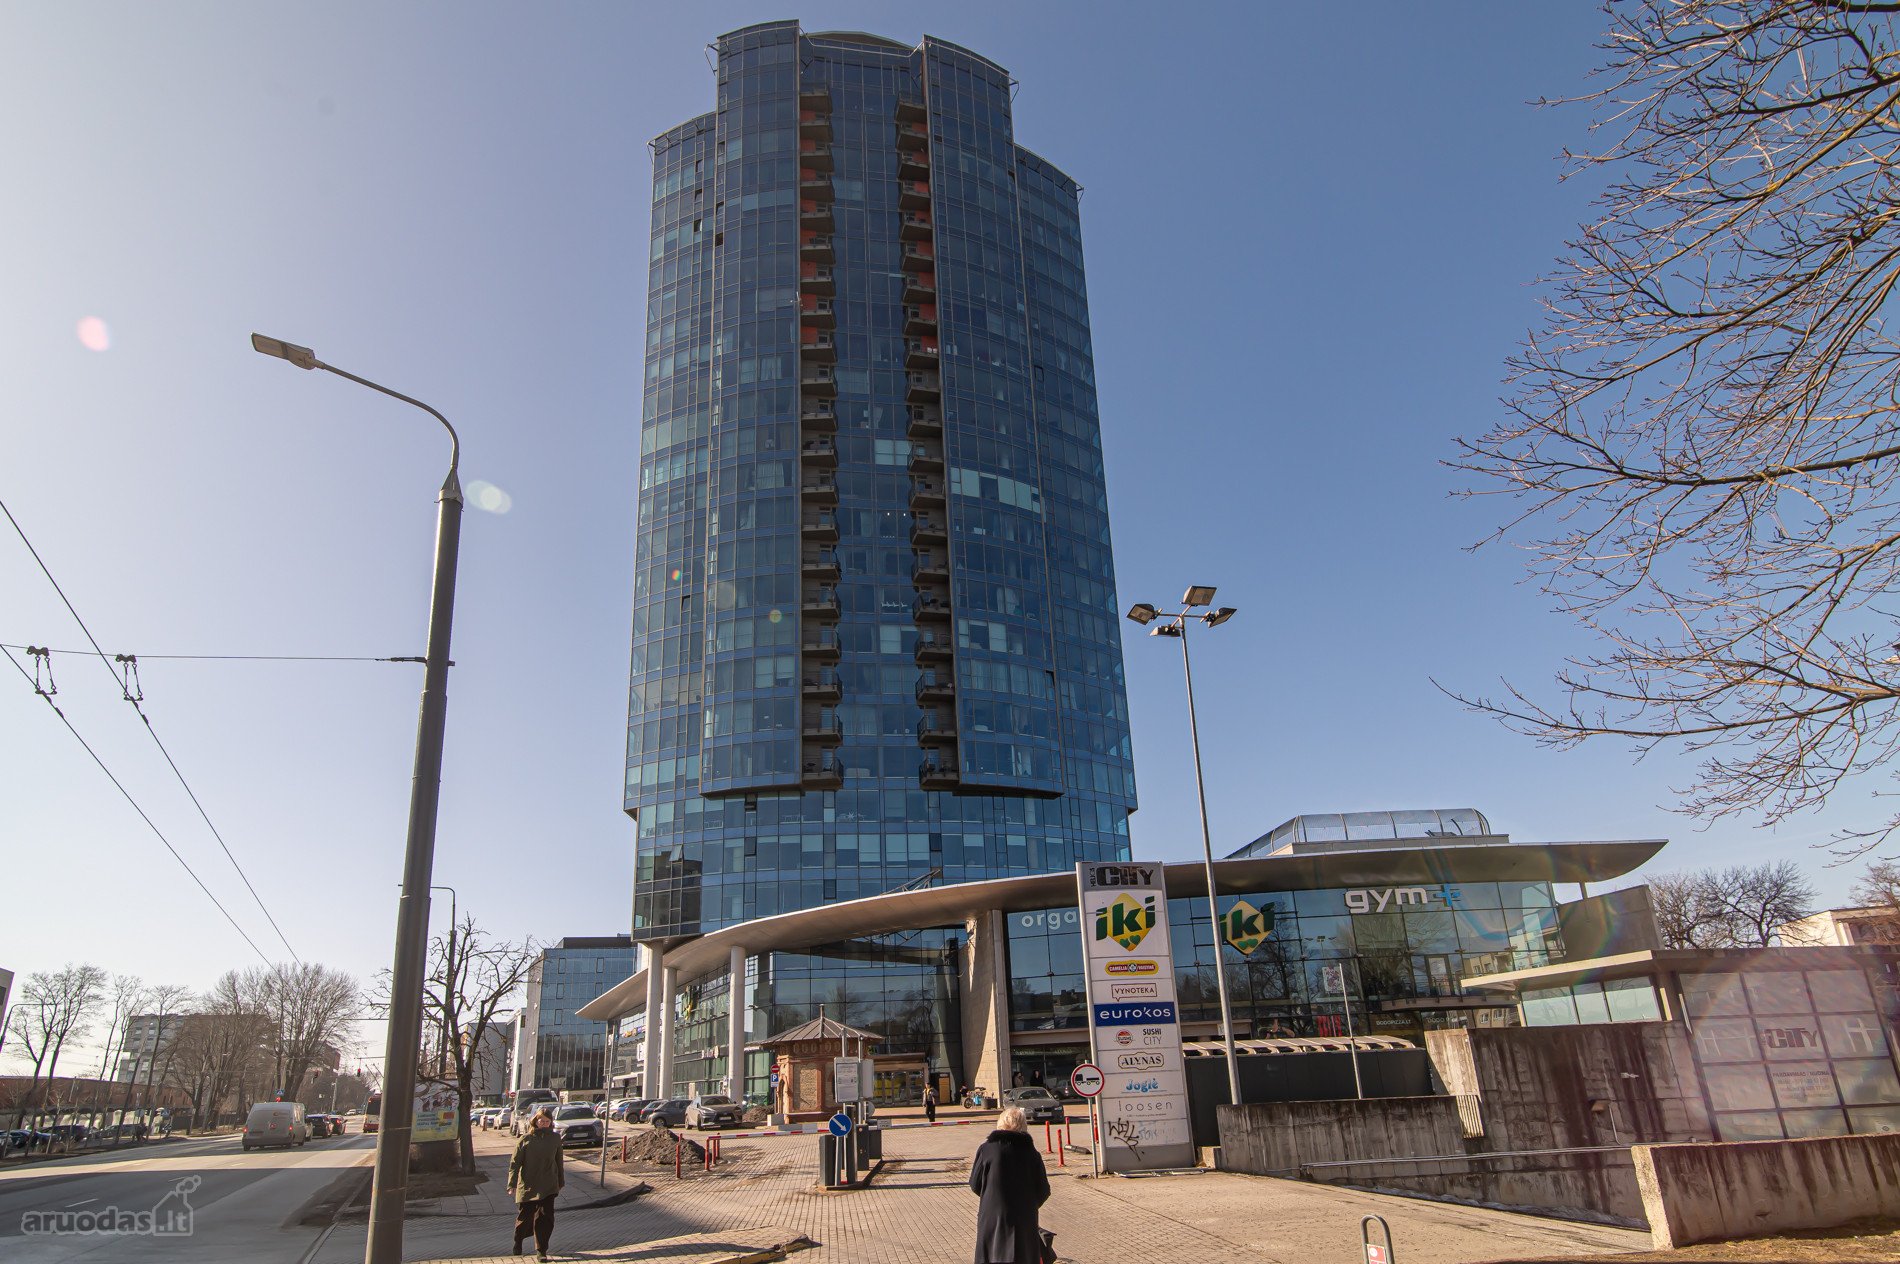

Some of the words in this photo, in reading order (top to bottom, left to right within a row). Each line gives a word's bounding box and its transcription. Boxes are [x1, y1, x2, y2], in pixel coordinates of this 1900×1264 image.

[1096, 896, 1156, 941] iki
[1114, 987, 1155, 995] VYNOTEKA
[1142, 1028, 1162, 1036] SUSHI
[1143, 1036, 1162, 1046] CITY
[1121, 1056, 1162, 1066] ALYNAS
[1118, 1100, 1173, 1112] loosen
